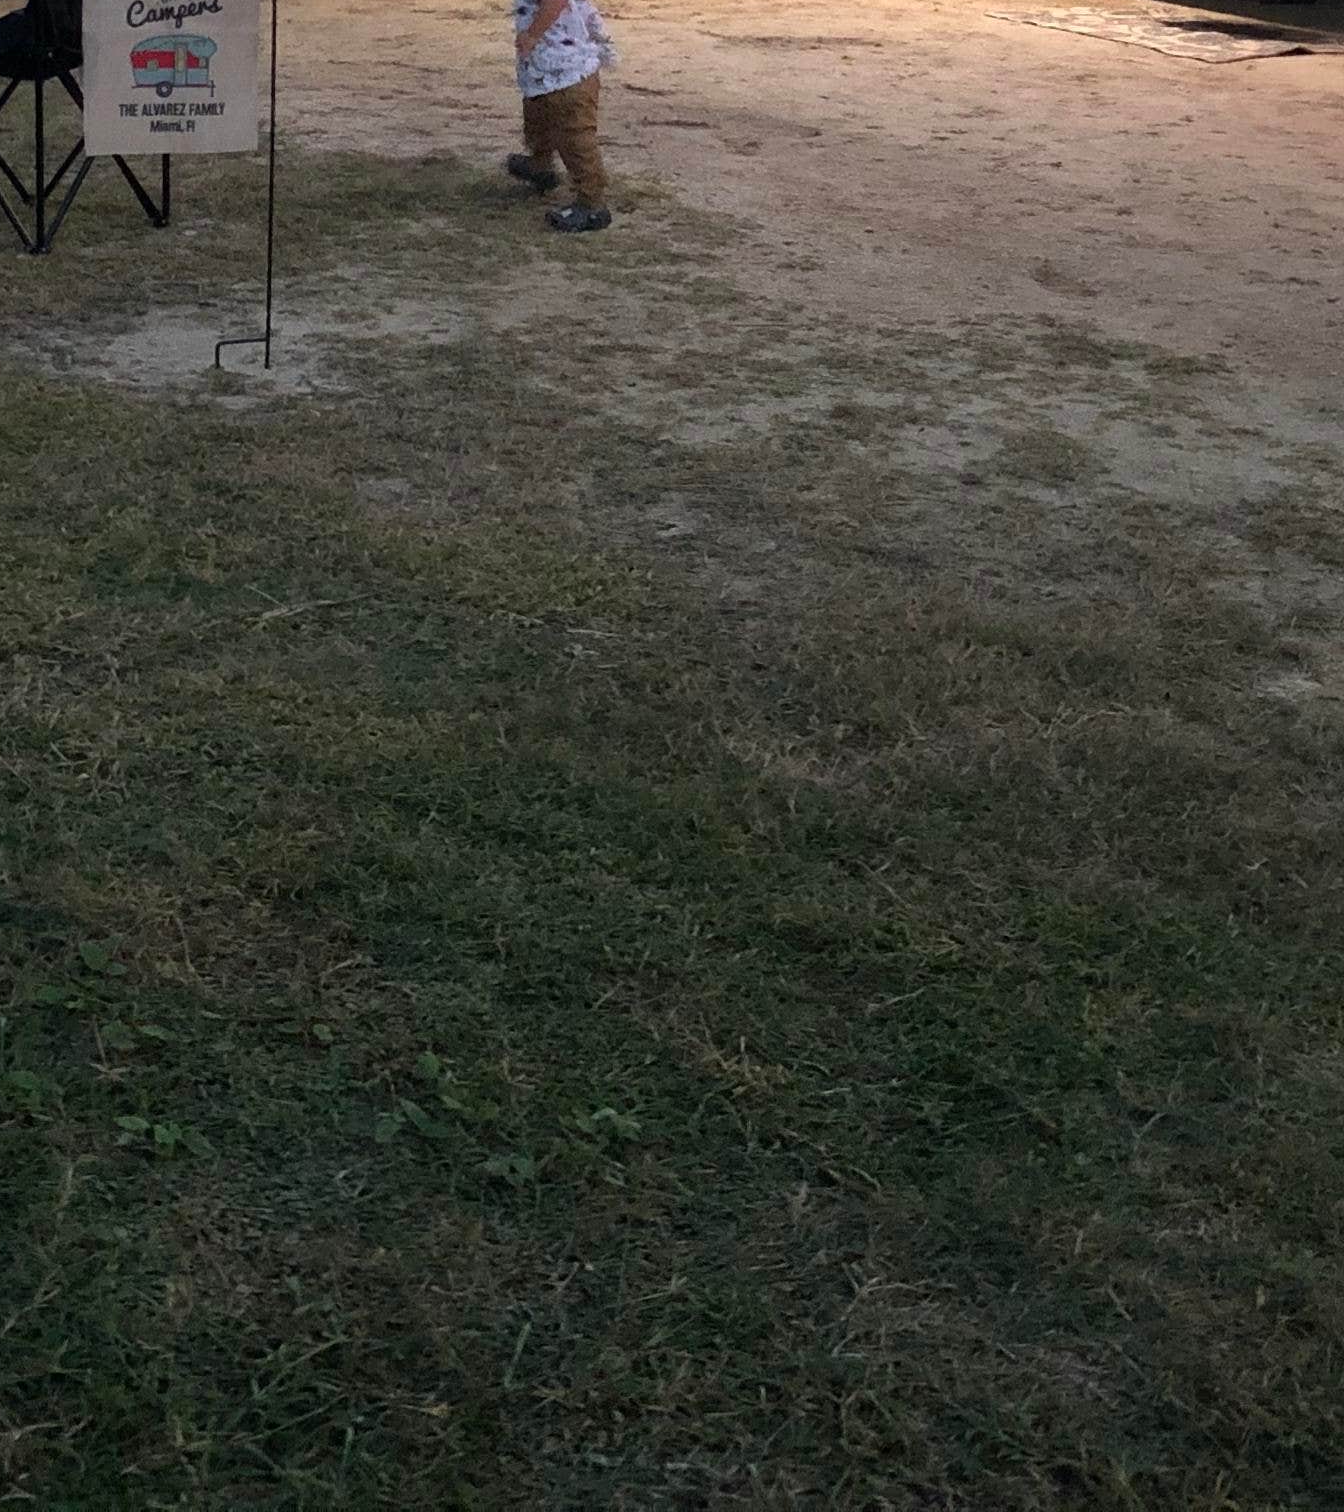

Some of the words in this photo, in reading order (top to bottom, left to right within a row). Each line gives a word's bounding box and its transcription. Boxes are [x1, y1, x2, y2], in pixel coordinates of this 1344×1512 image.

[118, 104, 137, 117] THE
[141, 103, 185, 116] ALVAREZ
[189, 102, 225, 116] FAMILY
